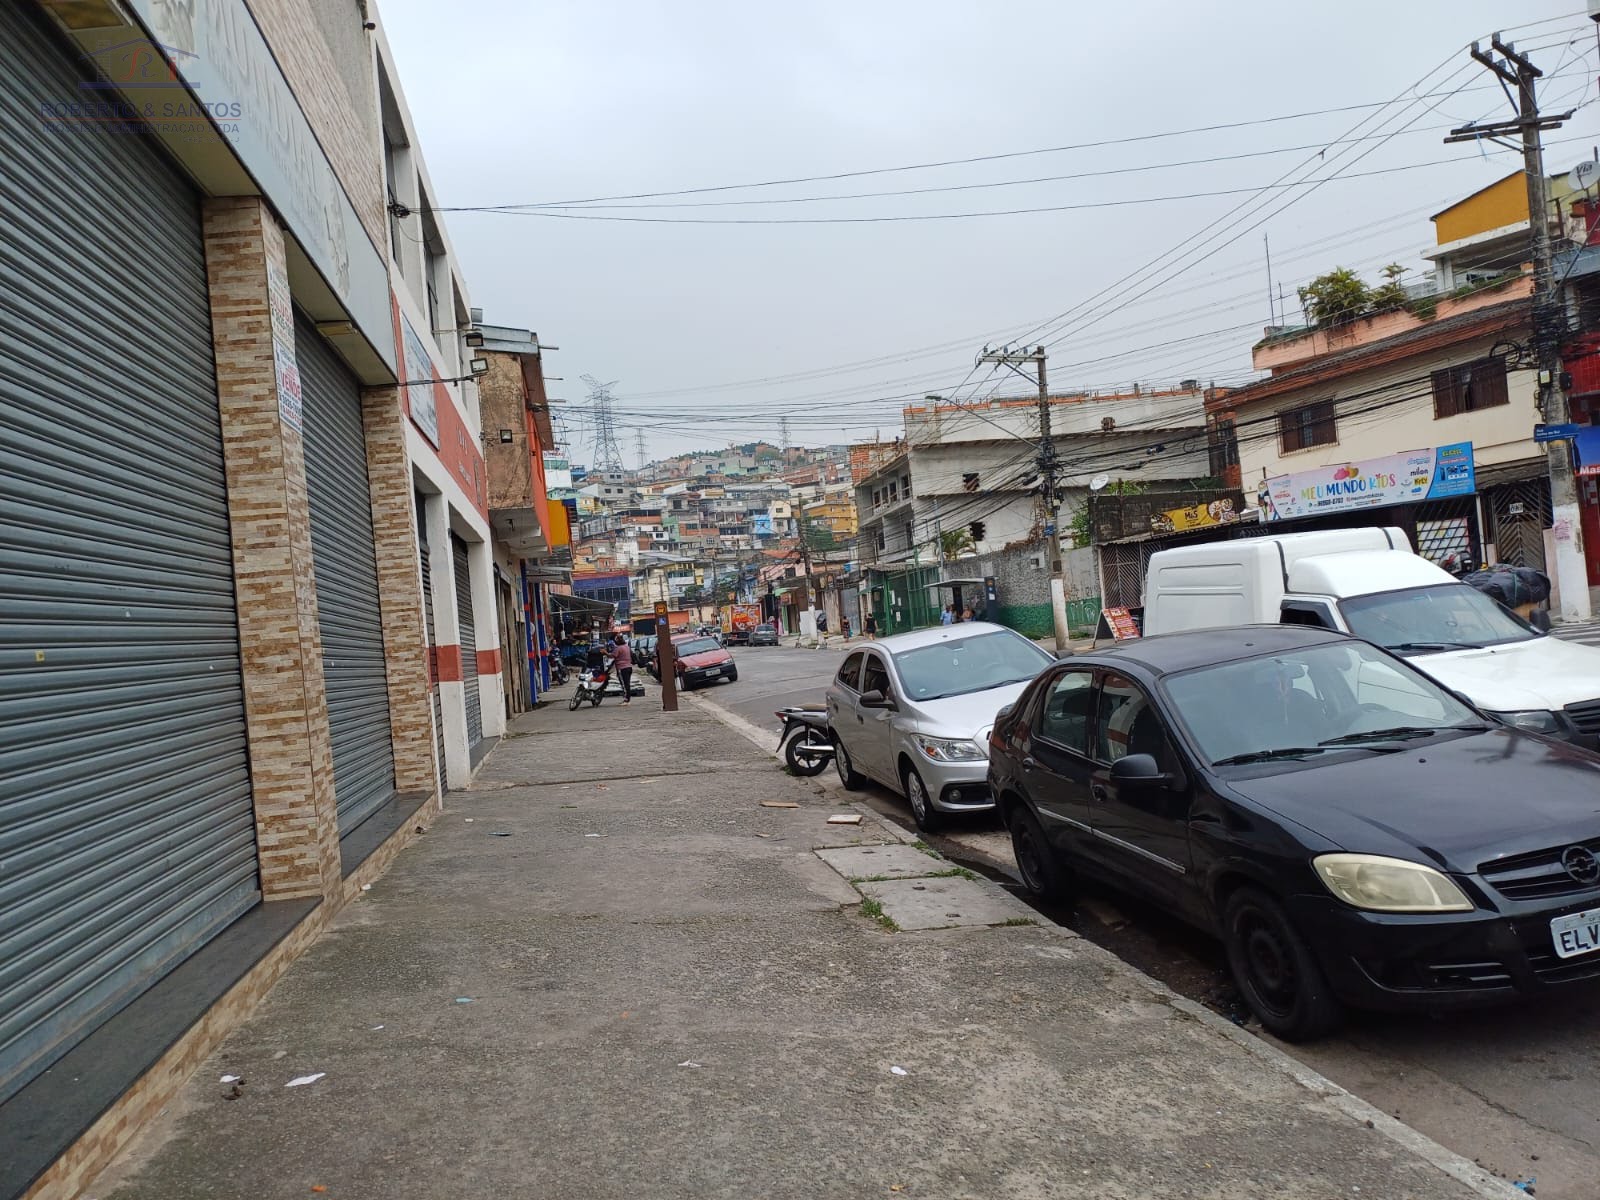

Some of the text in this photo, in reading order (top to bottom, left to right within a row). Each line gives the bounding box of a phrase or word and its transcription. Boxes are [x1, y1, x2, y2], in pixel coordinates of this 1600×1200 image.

[1301, 485, 1323, 500] MEU
[1326, 479, 1366, 496] MUNDO
[1369, 473, 1396, 490] KIDS
